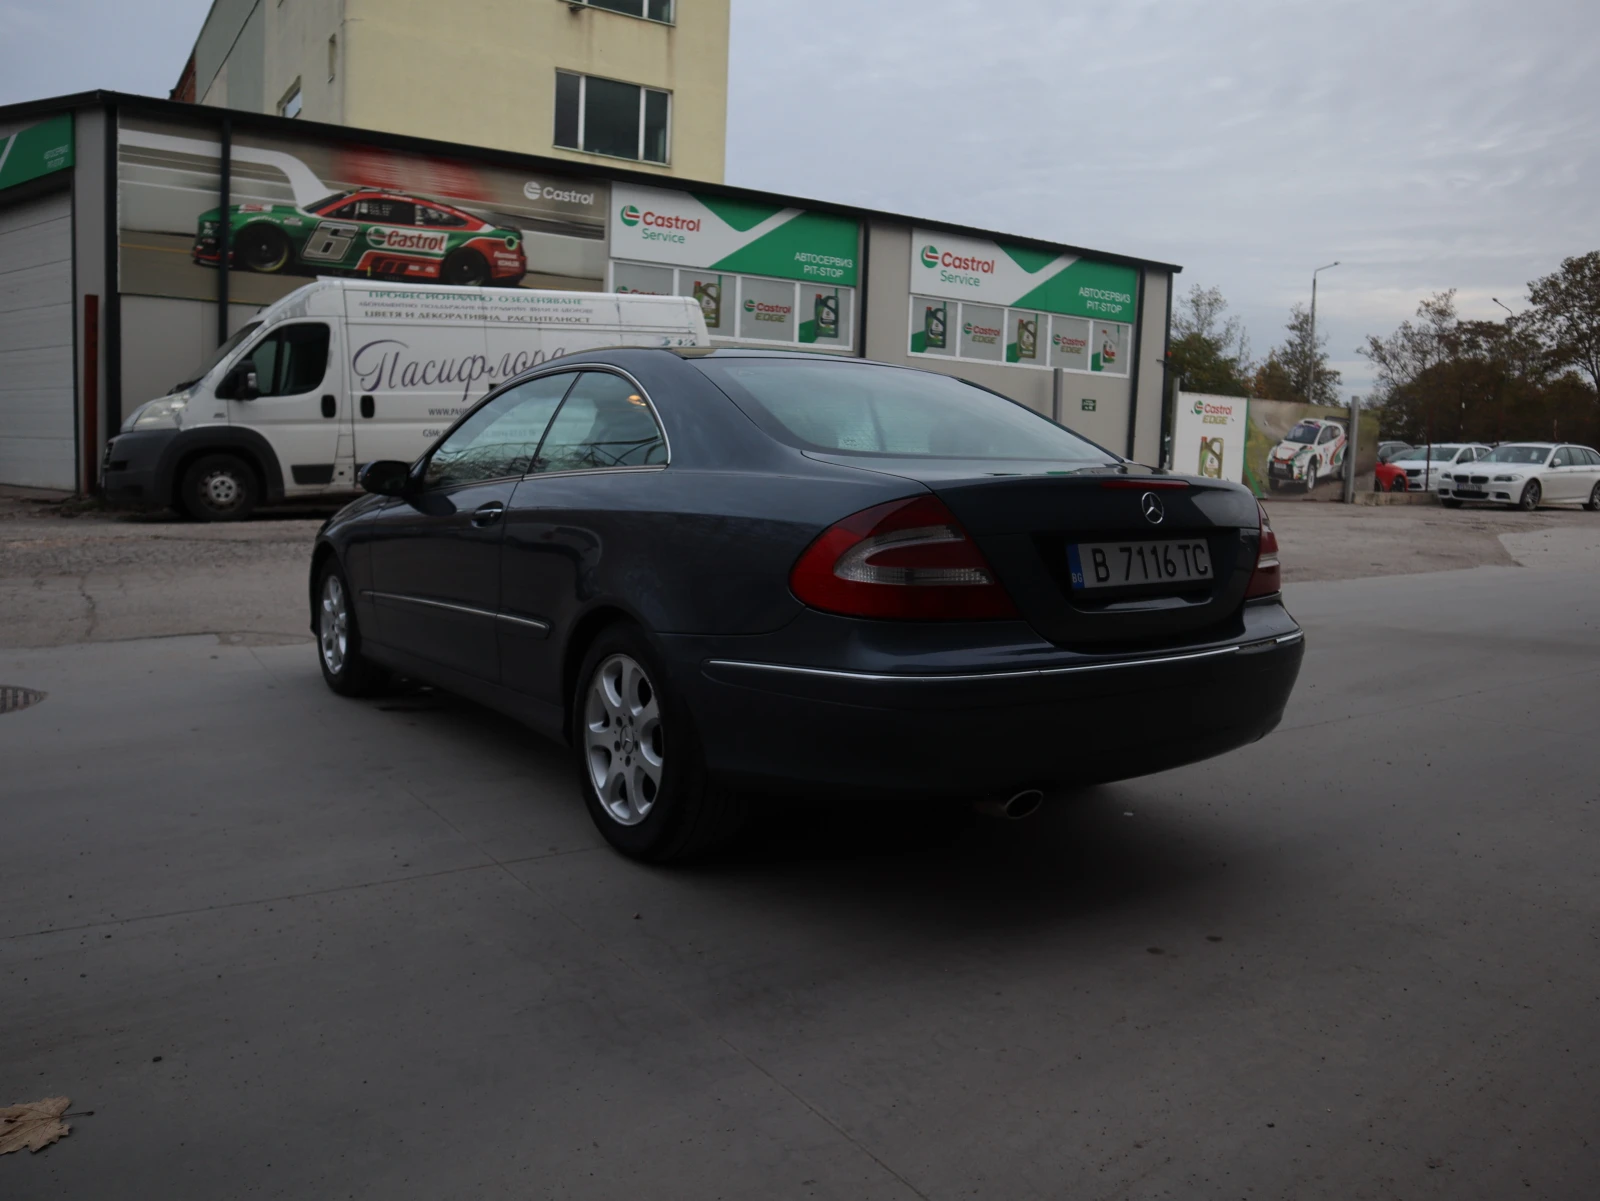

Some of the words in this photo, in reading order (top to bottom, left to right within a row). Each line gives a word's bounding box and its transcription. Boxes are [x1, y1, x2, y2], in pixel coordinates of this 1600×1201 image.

[542, 186, 594, 205] Castrol
[643, 211, 701, 232] Castrol
[303, 221, 361, 261] 6
[386, 230, 444, 252] Castrol
[642, 228, 685, 244] Service
[794, 252, 853, 269] АВТОСЕРВИЗ
[941, 252, 995, 274] Castrol
[803, 264, 844, 278] PIT-STOP
[940, 270, 980, 287] Service
[368, 291, 493, 303] ПРОФЕСИОНАЛНО
[1078, 287, 1131, 304] АВТОСЕРВИЗ
[756, 302, 792, 315] Castrol
[1086, 300, 1123, 314] PIT-STOP
[364, 310, 402, 319] ЦВЕТЯ
[417, 312, 501, 322] ДЕКОРАТИВНА
[507, 315, 591, 324] РАСТИТЕЛНОСТ
[755, 312, 786, 323] EDGE
[973, 325, 1001, 337] Castrol
[972, 335, 996, 345] EDGE
[1061, 336, 1087, 348] Castrol
[1204, 403, 1233, 416] Castrol
[1202, 414, 1229, 425] EDGE
[1091, 547, 1111, 583] B
[1071, 572, 1083, 583] BG
